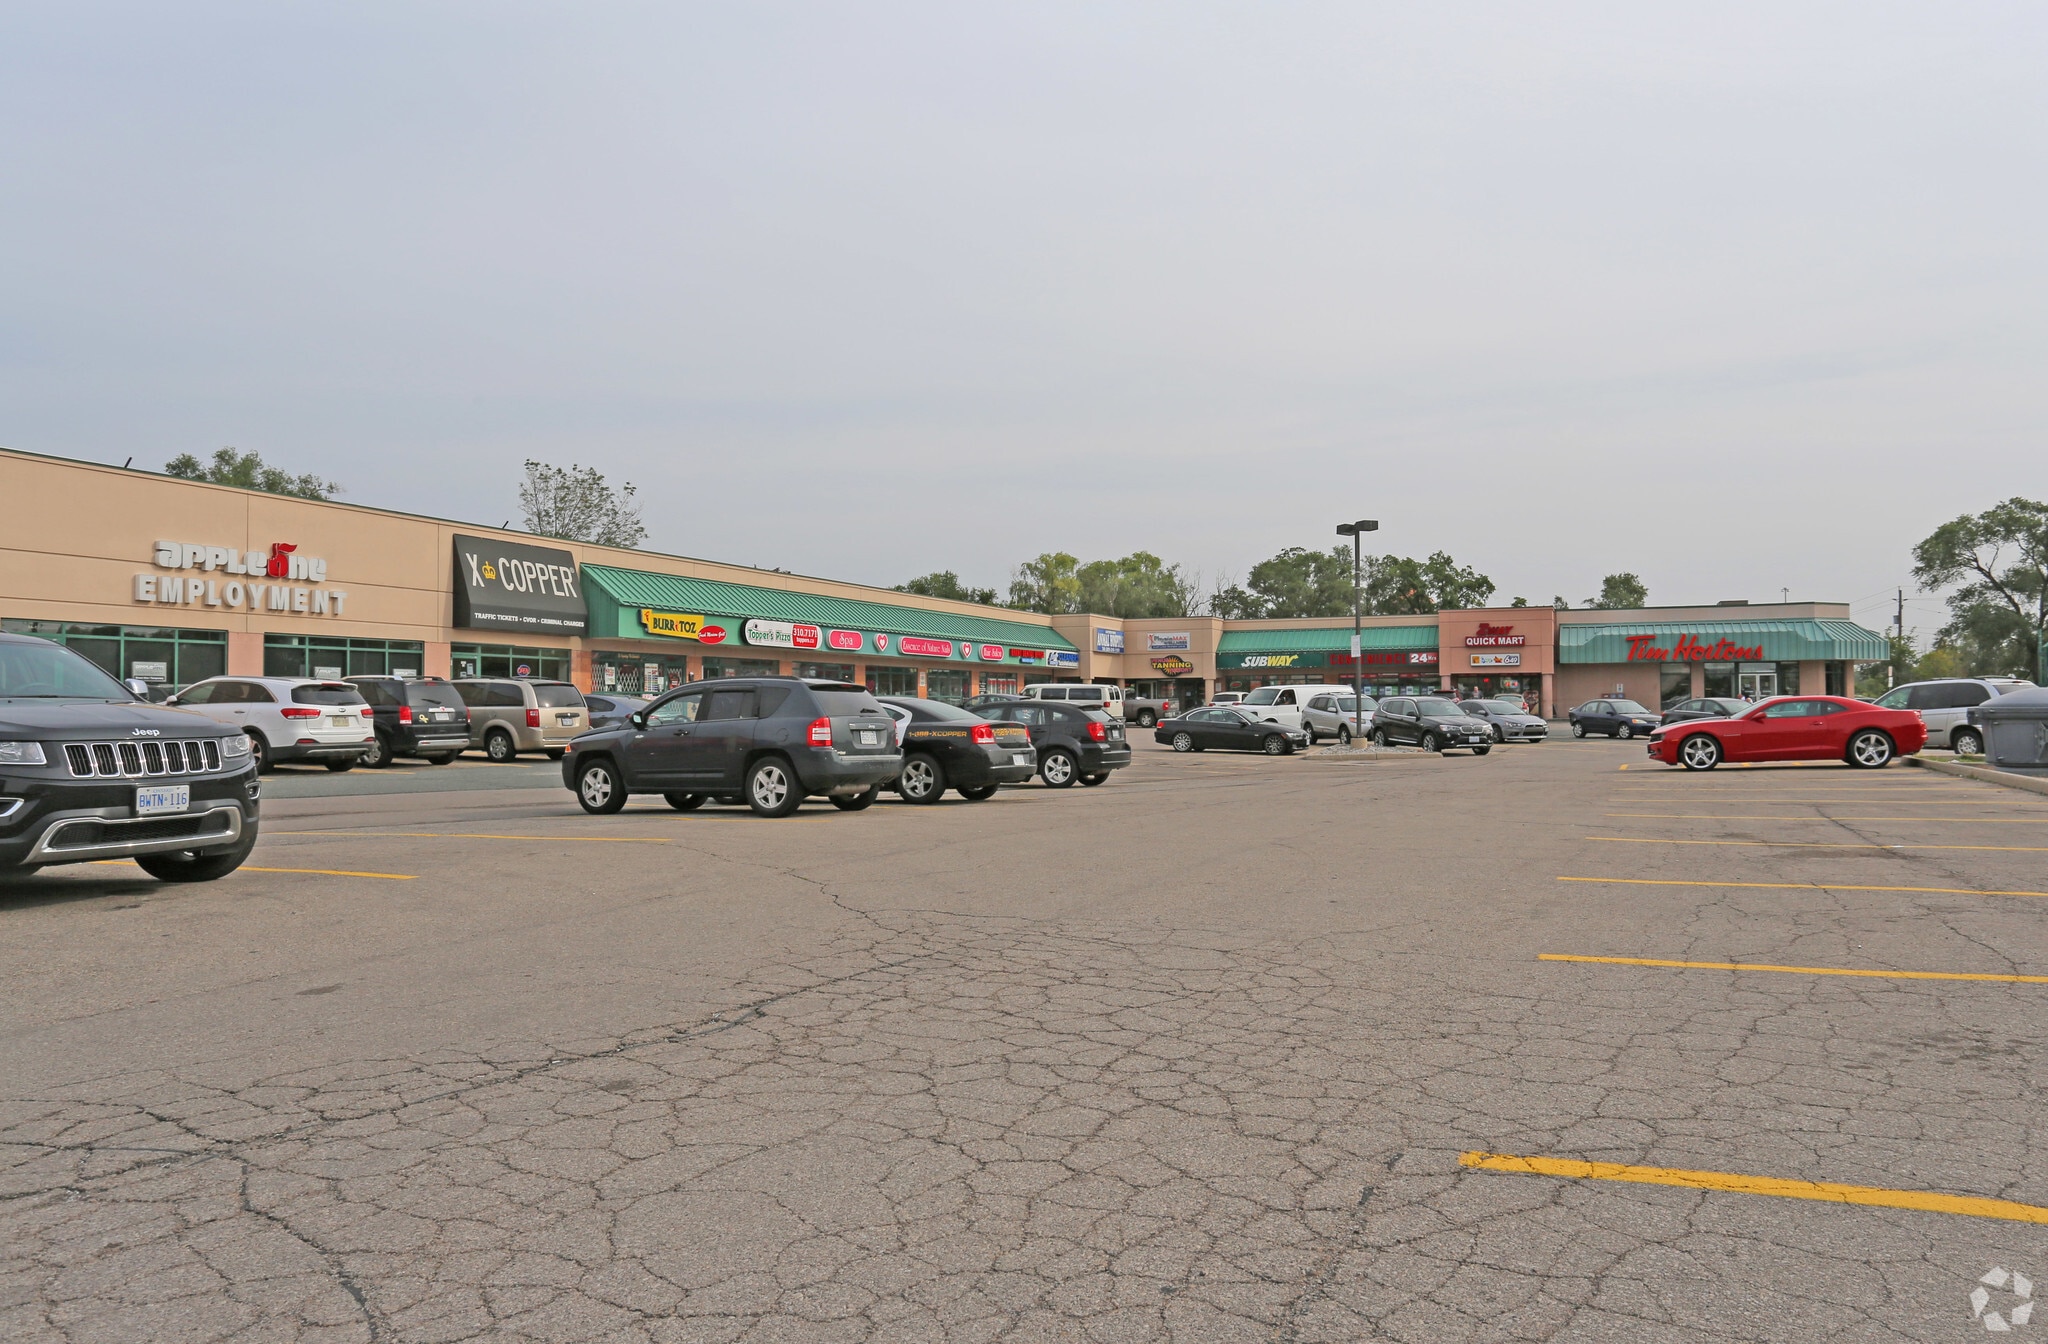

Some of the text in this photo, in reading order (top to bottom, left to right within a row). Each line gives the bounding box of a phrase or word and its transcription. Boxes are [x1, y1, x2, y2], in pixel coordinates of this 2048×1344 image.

[465, 552, 578, 598] X COPPER
[135, 573, 348, 615] EMPLOYMENT
[474, 612, 497, 621] TRAFFIC
[497, 614, 519, 622] TICKETS
[522, 616, 537, 624] CVOR
[747, 629, 791, 642] Topper's Pizza
[839, 633, 854, 648] Spa
[1466, 636, 1525, 646] QUICK MART
[1625, 633, 1765, 662] Tim Hortons
[1241, 654, 1299, 668] SUBWAY
[1410, 653, 1428, 663] 24
[131, 727, 161, 737] Jeep
[139, 792, 187, 808] BWTN 116
